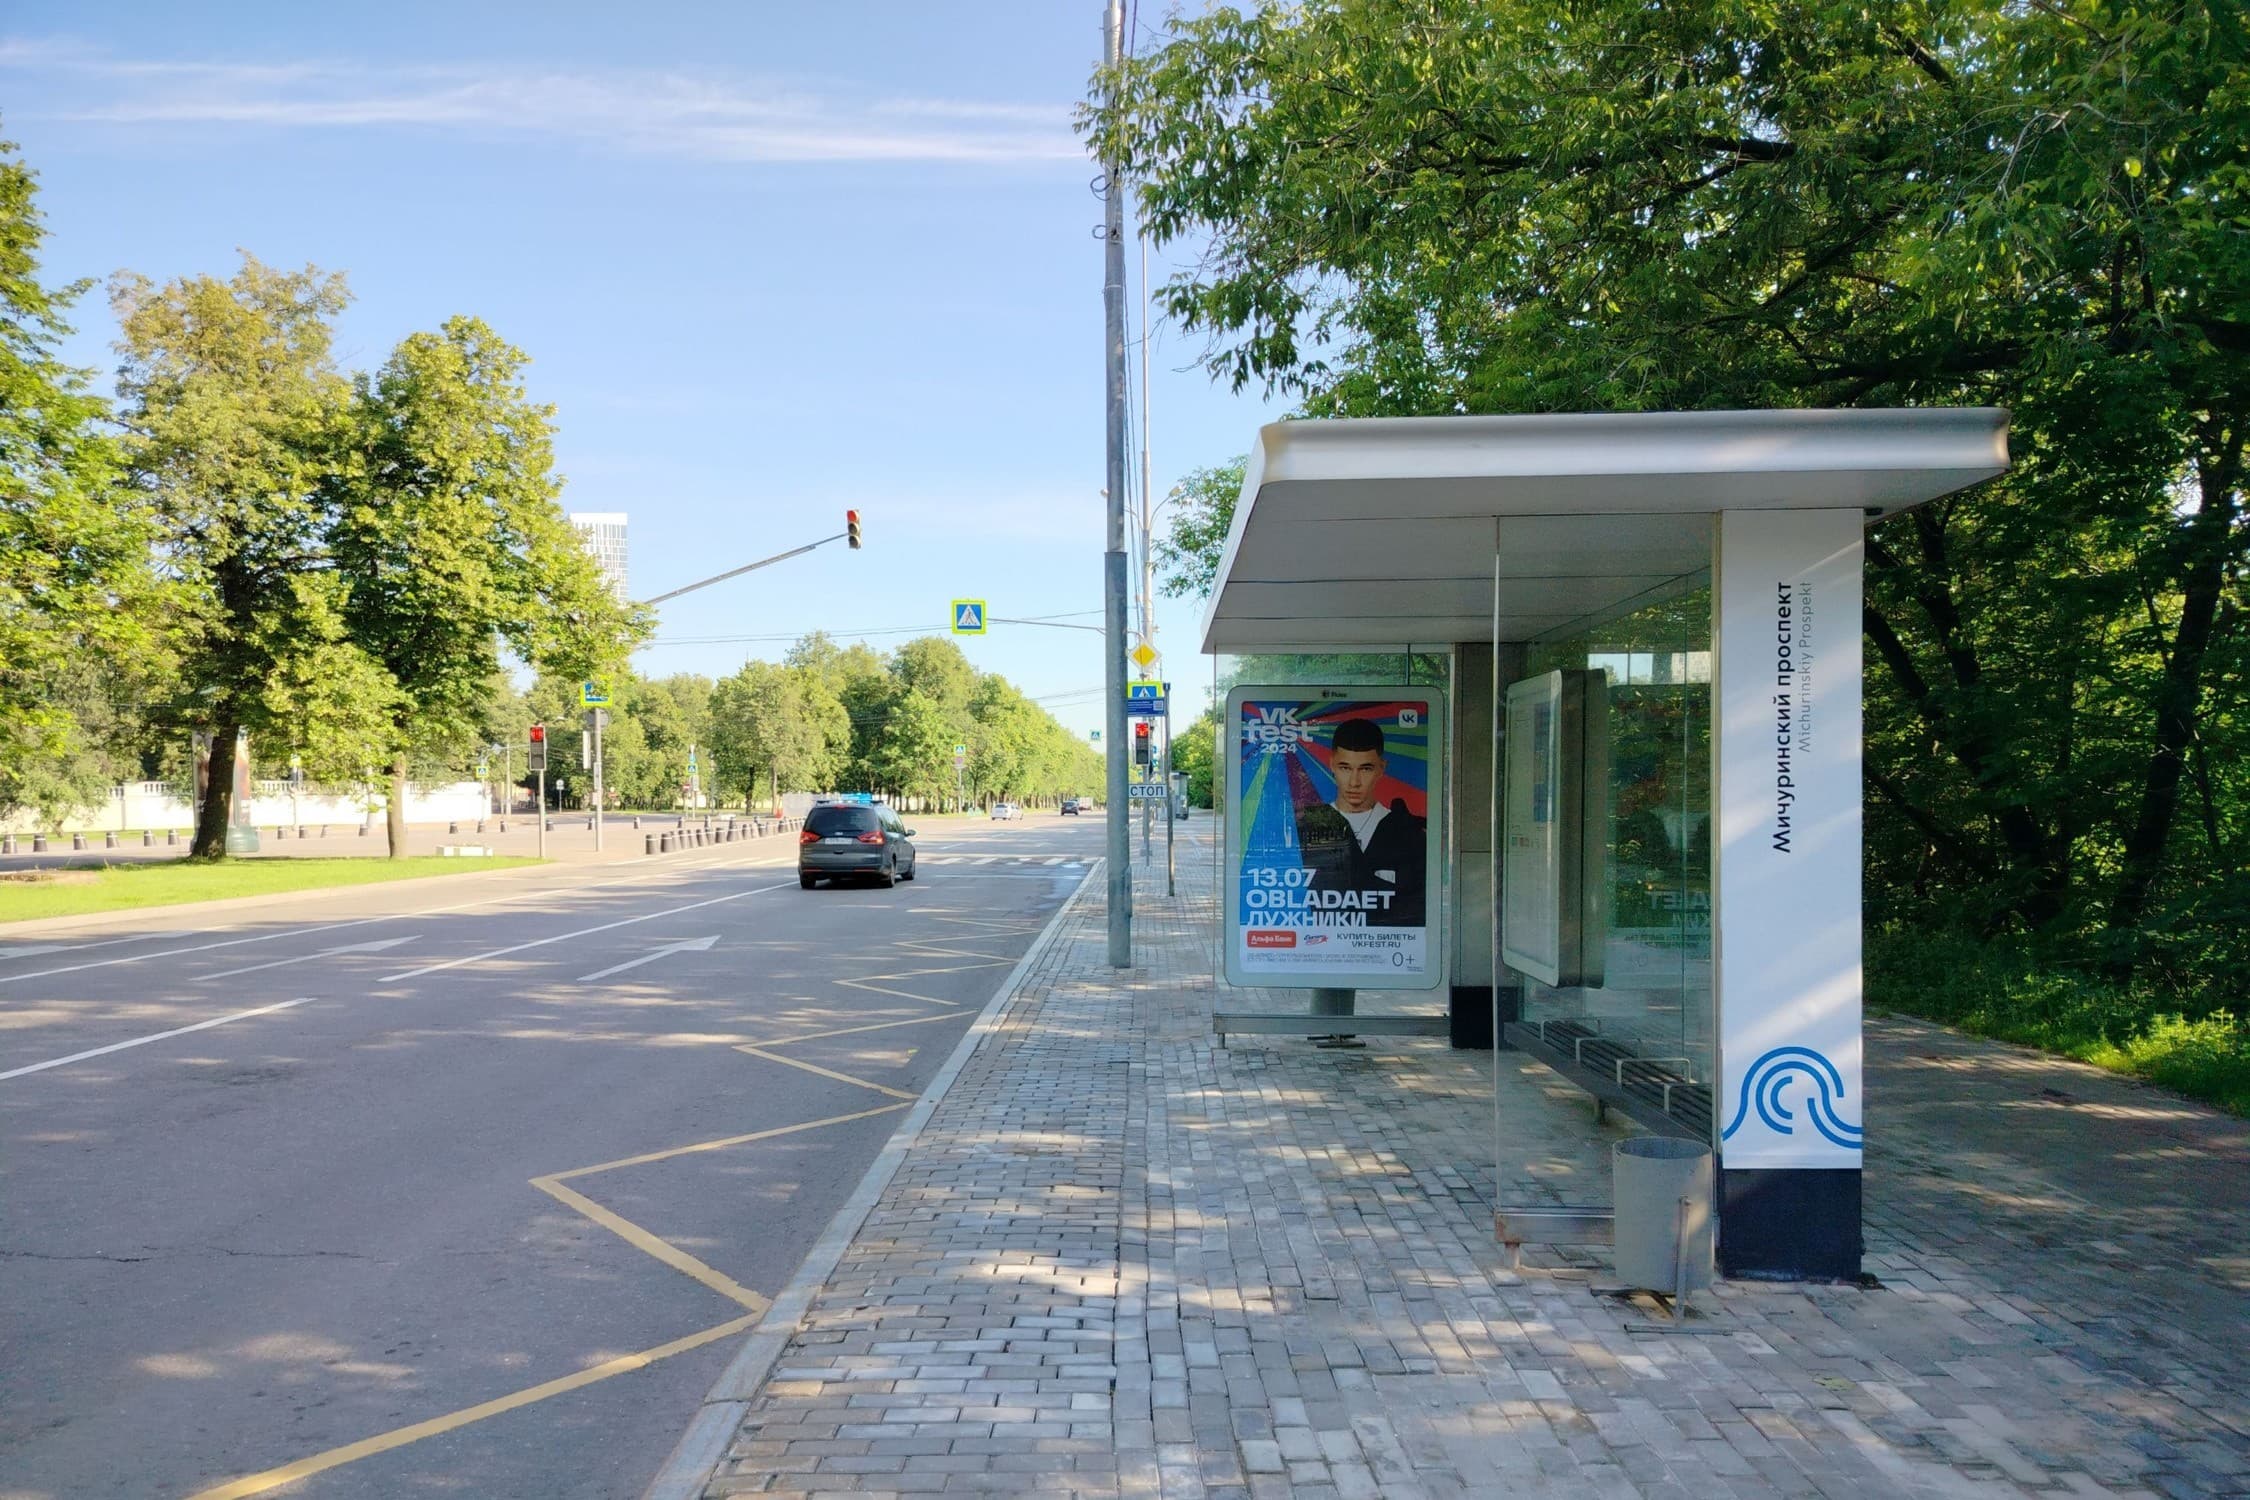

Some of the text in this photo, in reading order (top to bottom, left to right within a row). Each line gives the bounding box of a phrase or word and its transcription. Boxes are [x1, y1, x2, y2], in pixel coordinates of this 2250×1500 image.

[1798, 582, 1814, 753] Michurinskiy Prospekt
[1259, 707, 1298, 724] VK
[1773, 582, 1795, 853] Мичуринский проспект
[1242, 718, 1317, 743] fest
[1260, 743, 1298, 754] 2024
[1130, 786, 1163, 796] СТОП
[1247, 868, 1317, 887] 13.07
[1246, 889, 1396, 909] OBLADAET
[1247, 910, 1367, 927] ЛУЖНИКИ
[1336, 933, 1374, 941] КУПИТЬ
[1376, 933, 1416, 941] БИЛЕТЫ
[1391, 951, 1415, 967] 0+
